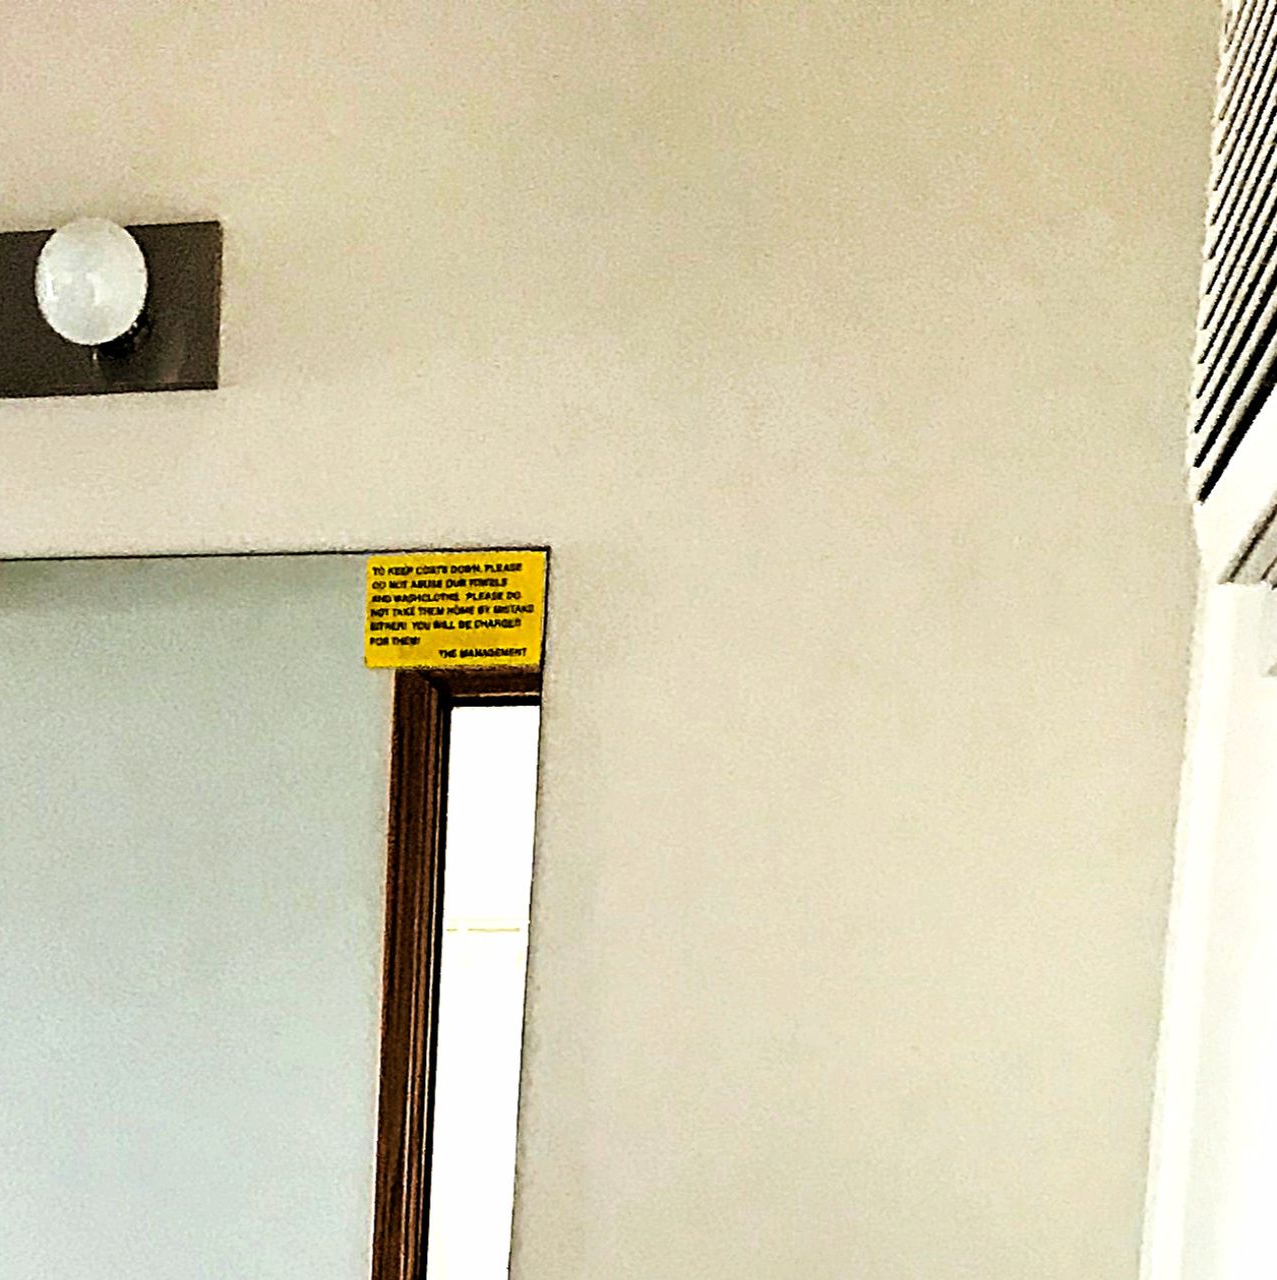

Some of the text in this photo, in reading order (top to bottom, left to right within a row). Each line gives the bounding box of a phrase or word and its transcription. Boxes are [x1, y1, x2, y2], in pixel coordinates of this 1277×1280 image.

[372, 566, 385, 576] TO
[388, 566, 413, 576] KEEP
[415, 565, 448, 575] COSTS
[484, 563, 522, 572] PLEASE
[371, 578, 508, 589] DO NOT ABUSE OUR TOWELS
[371, 594, 392, 603] AND
[465, 591, 503, 601] PLEASE
[506, 591, 521, 600] DO
[370, 604, 534, 617] NOT TAKE THEM HOME BY MISTAKE
[412, 621, 431, 630] YOU
[433, 620, 455, 630] WILL
[458, 620, 472, 630] BE
[474, 618, 521, 628] CHARGED
[370, 637, 389, 646] FOR
[438, 647, 527, 659] THE MANAGEMENT
